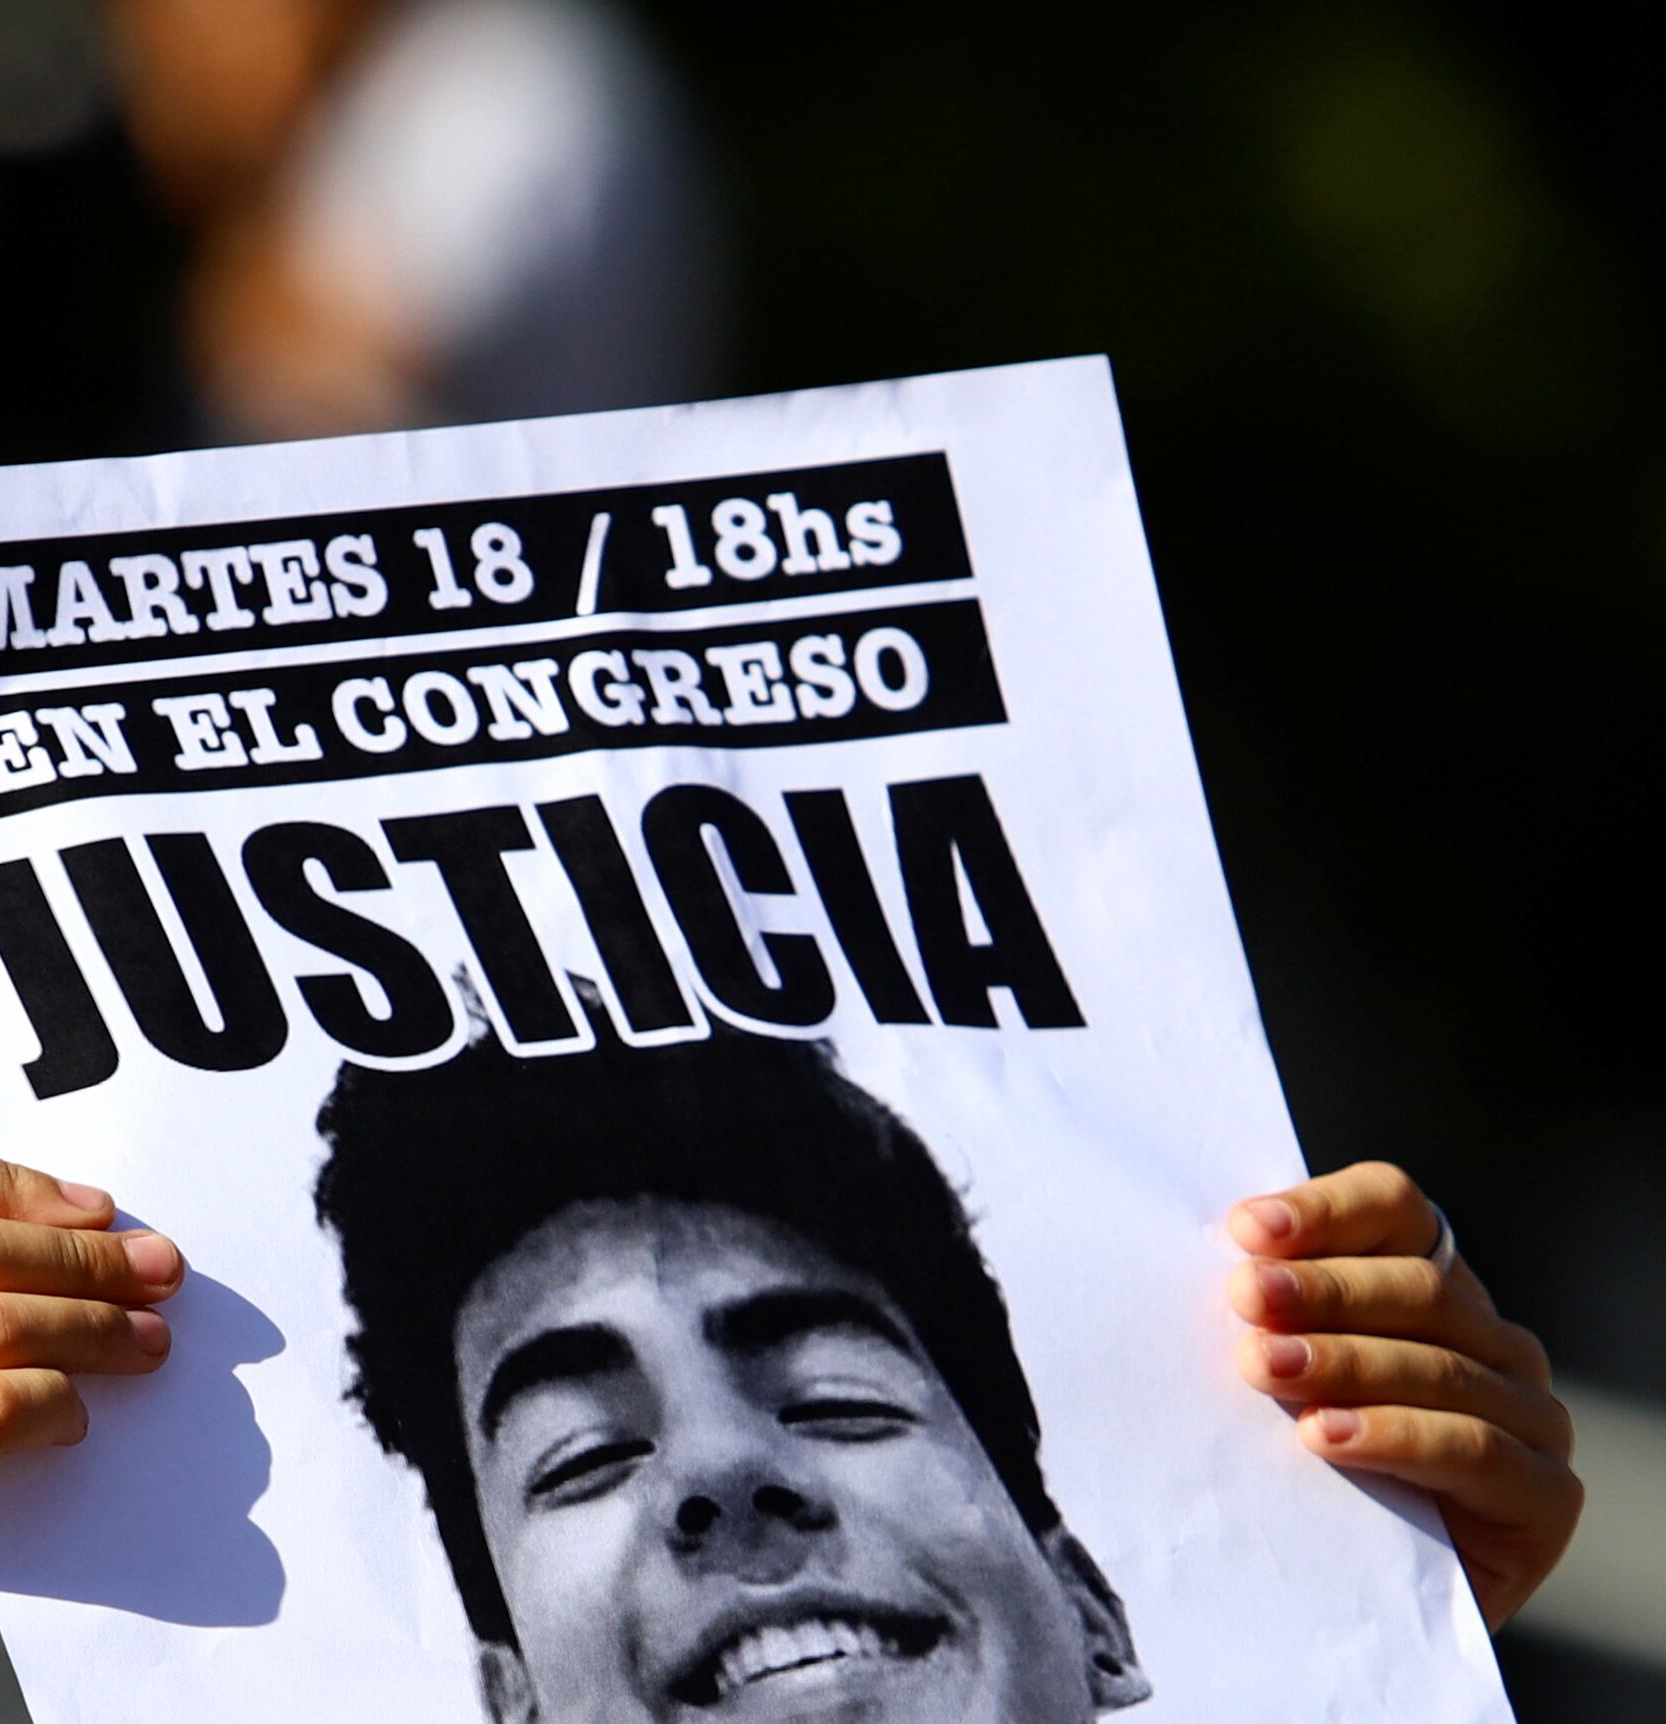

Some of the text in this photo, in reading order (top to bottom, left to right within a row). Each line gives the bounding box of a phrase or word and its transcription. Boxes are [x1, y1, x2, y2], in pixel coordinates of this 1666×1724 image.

[413, 521, 534, 606] 18
[575, 512, 612, 616] /
[649, 495, 904, 593] 18hs
[161, 687, 323, 773] EL
[330, 627, 931, 754] CONGRESO
